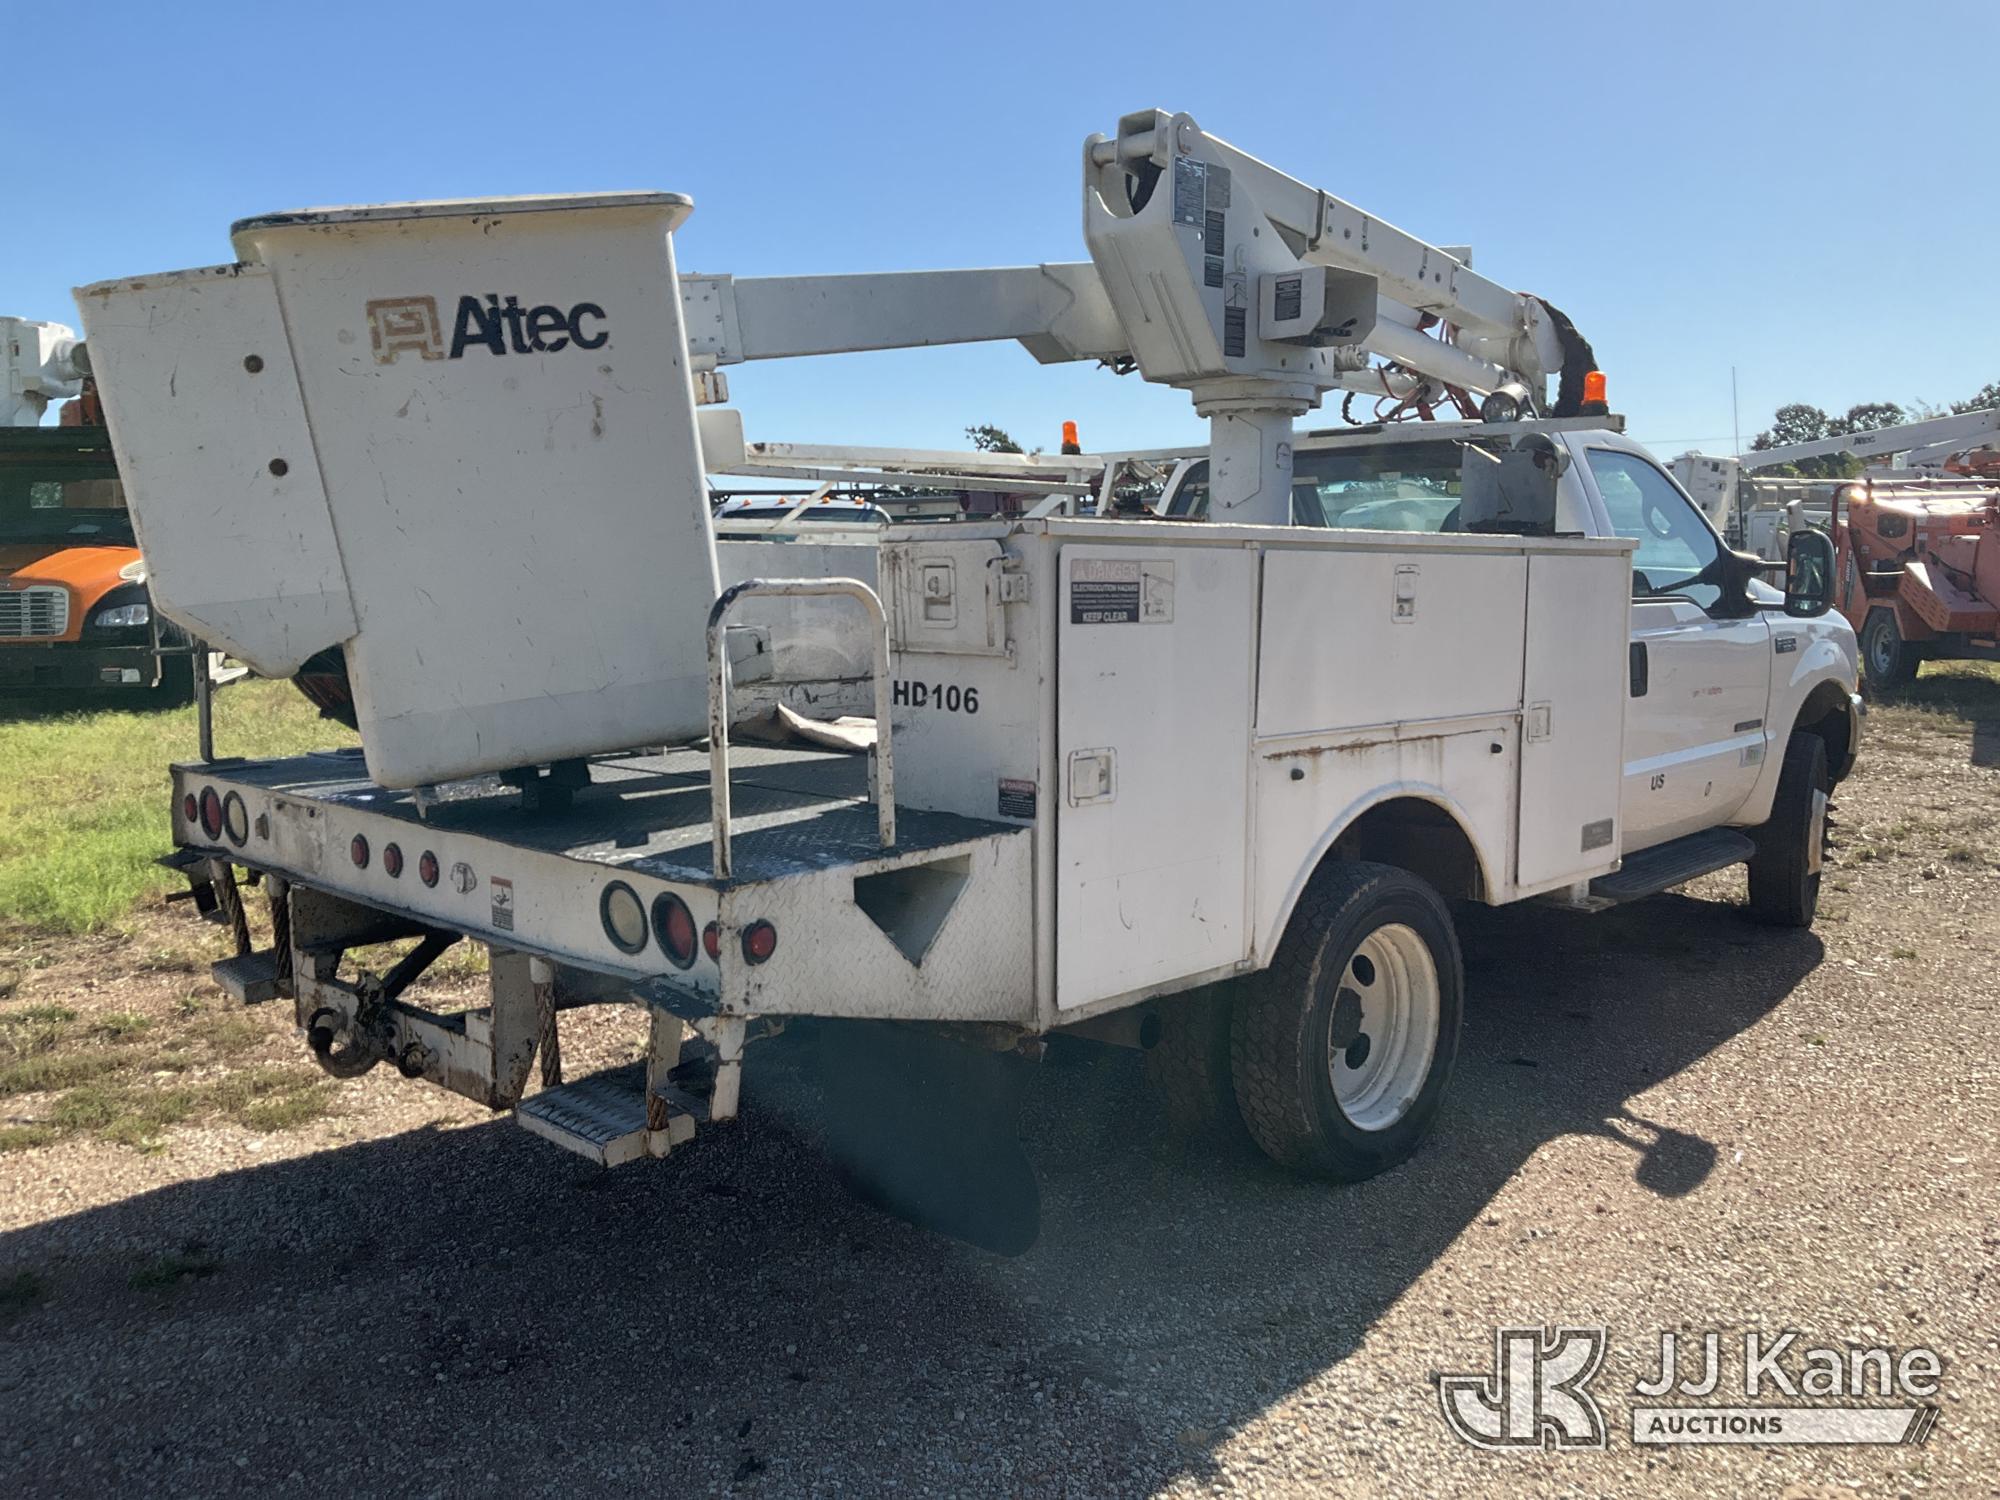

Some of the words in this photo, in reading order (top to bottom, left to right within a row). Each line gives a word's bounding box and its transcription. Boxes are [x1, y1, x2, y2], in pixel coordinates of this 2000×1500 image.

[1088, 562, 1137, 579] DANGER
[1082, 611, 1102, 622] KEEP
[1103, 611, 1128, 622] CLEAR
[893, 680, 979, 714] HD106
